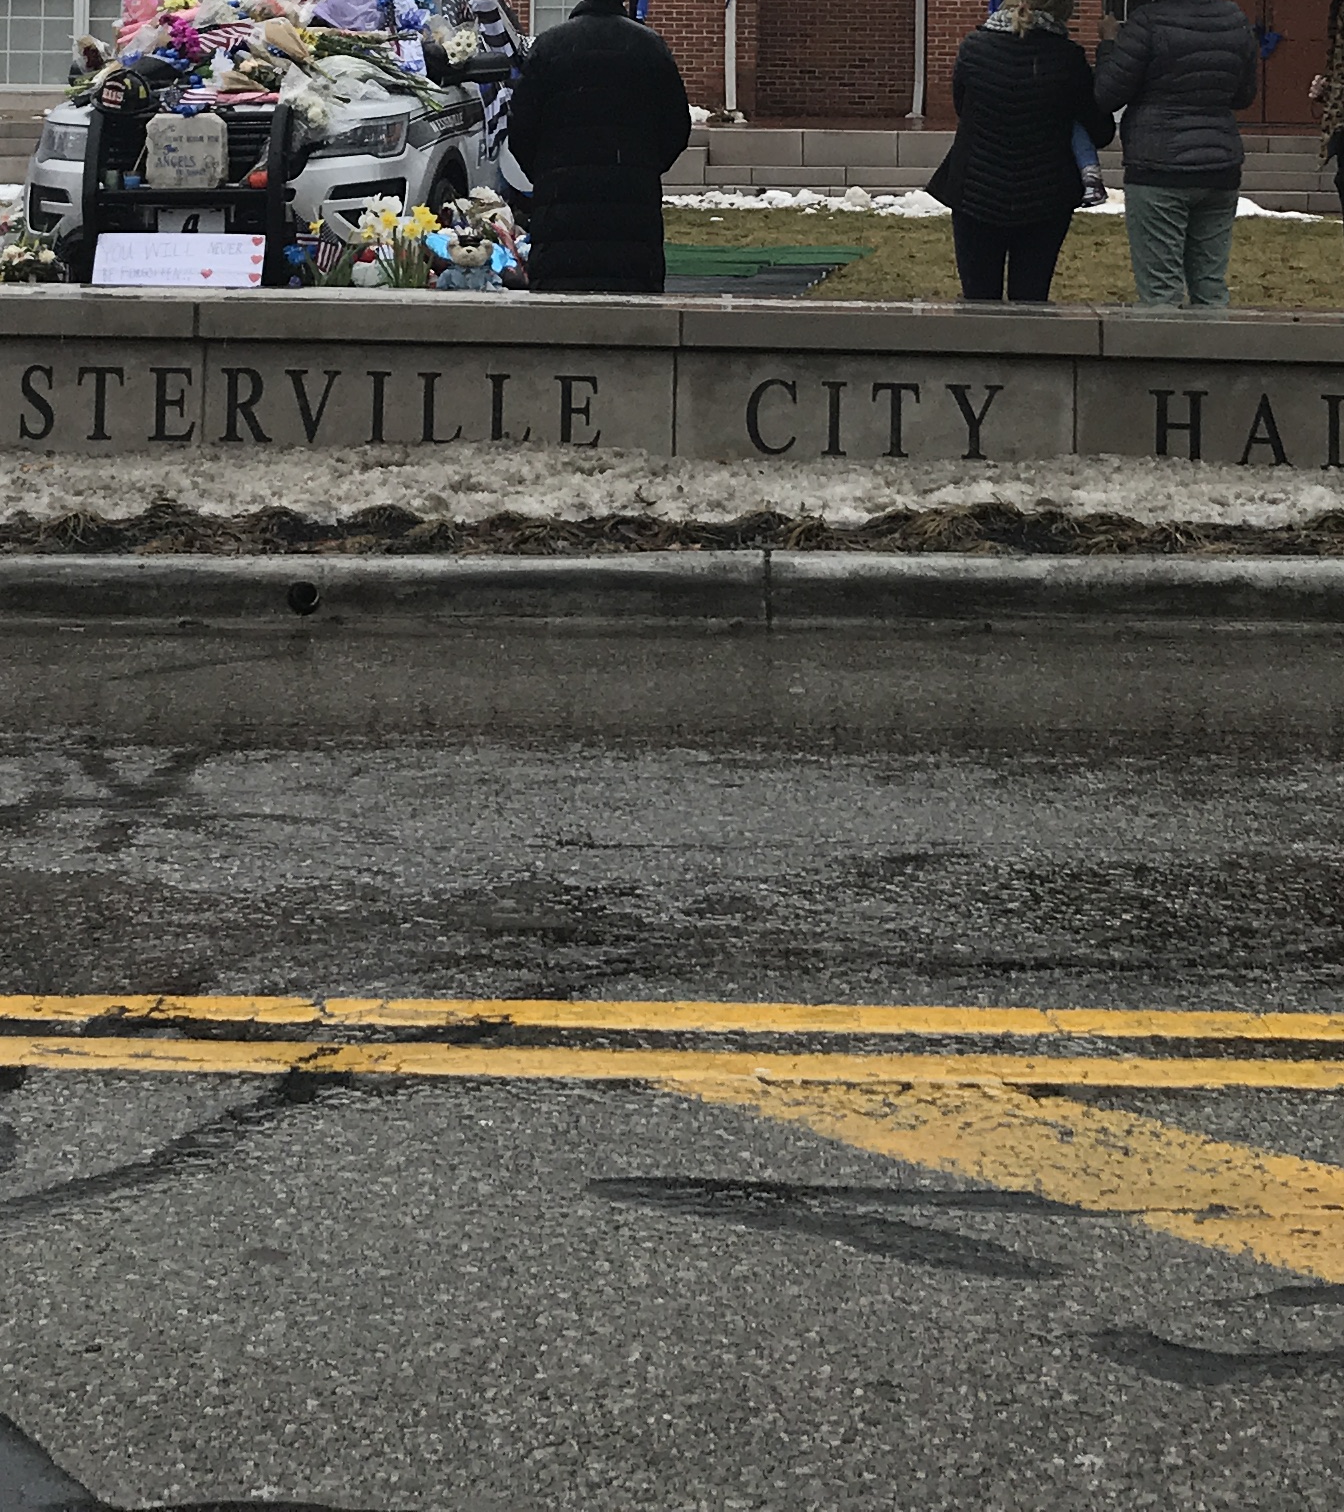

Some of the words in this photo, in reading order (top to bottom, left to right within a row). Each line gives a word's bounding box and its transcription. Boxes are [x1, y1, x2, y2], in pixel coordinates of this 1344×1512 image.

[103, 243, 134, 263] YOU
[145, 241, 195, 260] WILL
[207, 241, 244, 256] NEVER
[745, 378, 1005, 460] CITY
